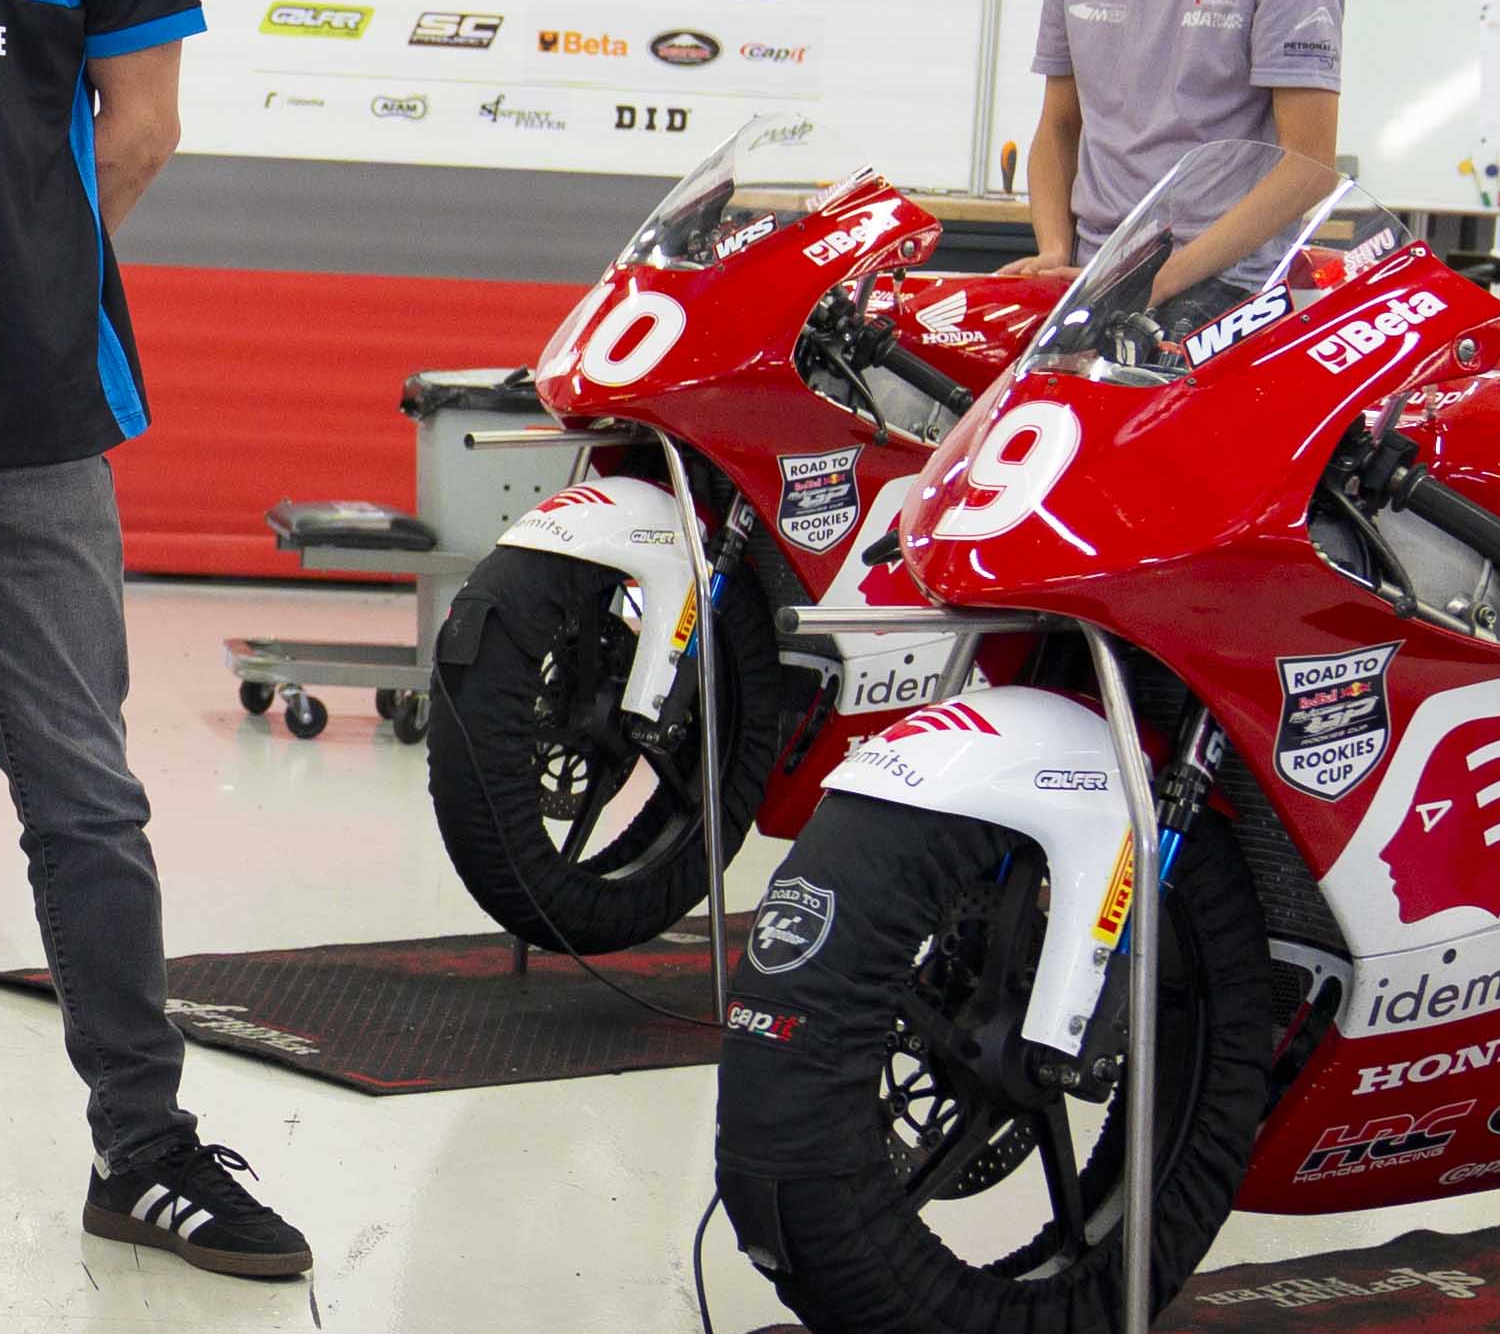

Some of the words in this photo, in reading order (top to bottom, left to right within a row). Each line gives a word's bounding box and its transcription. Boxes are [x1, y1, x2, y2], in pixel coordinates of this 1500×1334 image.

[416, 11, 505, 39] SC
[563, 32, 629, 58] Beta
[715, 214, 774, 259] WRS
[535, 282, 687, 387] 10
[1185, 285, 1288, 365] WRS
[1345, 291, 1447, 355] Beta
[921, 331, 988, 344] HONDA
[790, 462, 828, 477] ROAD
[831, 457, 849, 470] TO
[932, 401, 1081, 540] 9
[522, 517, 574, 543] mitsu
[790, 511, 849, 533] ROOKIES
[807, 528, 834, 543] CUP
[630, 529, 675, 544] GALFER
[1294, 662, 1346, 689] ROAD
[1353, 656, 1379, 674] TO
[860, 748, 924, 788] mitsu
[1293, 737, 1375, 771] ROOKIES
[1035, 770, 1109, 791] GALFER
[1315, 764, 1354, 785] CUP
[802, 893, 820, 909] TO
[1297, 1099, 1477, 1176] HRC
[1293, 1163, 1366, 1185] Honda
[1370, 1147, 1446, 1171] RACING
